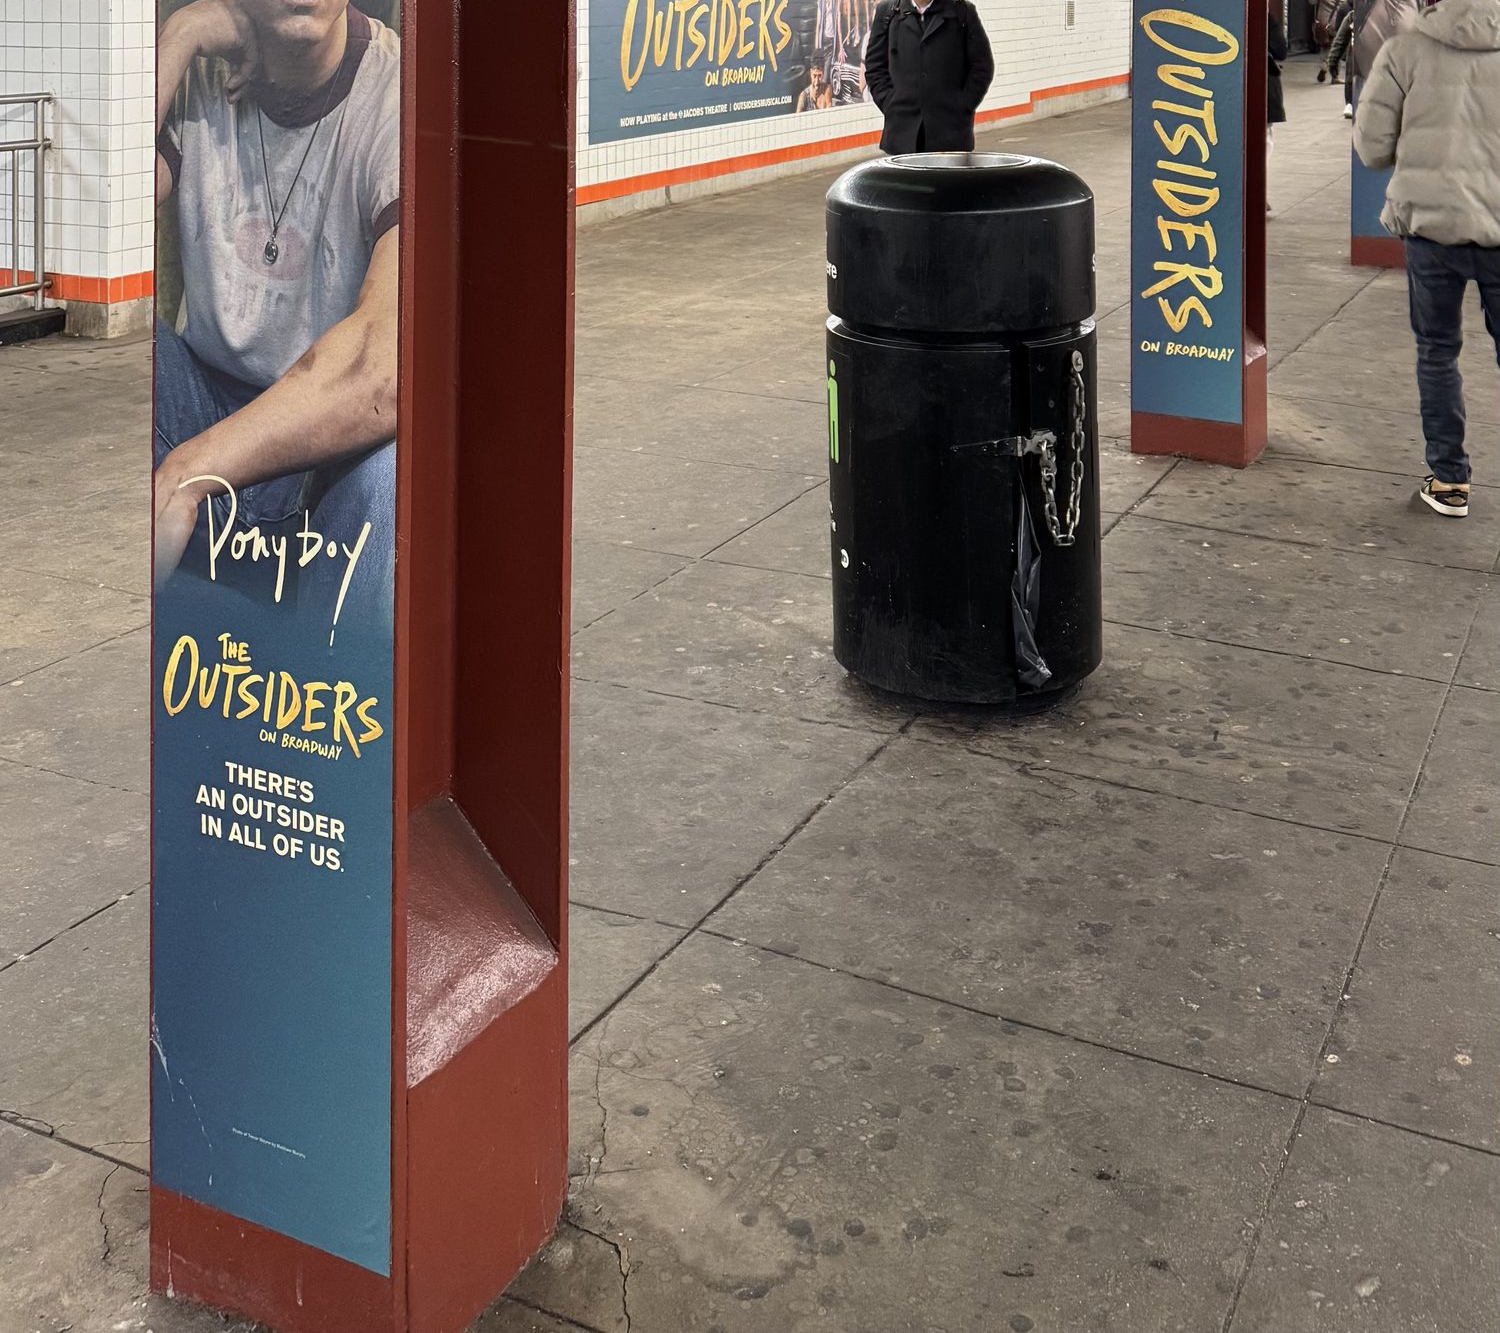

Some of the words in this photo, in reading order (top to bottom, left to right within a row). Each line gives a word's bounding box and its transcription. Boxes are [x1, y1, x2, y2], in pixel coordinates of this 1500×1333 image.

[705, 69, 719, 87] ON
[722, 65, 766, 87] BROADWAY
[620, 116, 635, 127] NOW
[636, 112, 661, 125] PLAYING
[705, 103, 728, 115] THEATRE
[1139, 8, 1240, 333] OUTSIDERS
[1141, 340, 1160, 353] ON
[1165, 342, 1235, 362] BROADWAY
[217, 632, 252, 663] THE
[162, 634, 384, 759] OUTSIDERS
[259, 728, 276, 743] ON
[281, 735, 343, 761] BROADWAY
[225, 761, 314, 803] THERE'S
[196, 784, 226, 810] AN
[232, 794, 346, 843] OUTSIDER
[201, 813, 222, 839] IN
[229, 824, 266, 851] ALL
[273, 837, 303, 859] OF
[310, 843, 344, 873] US.
